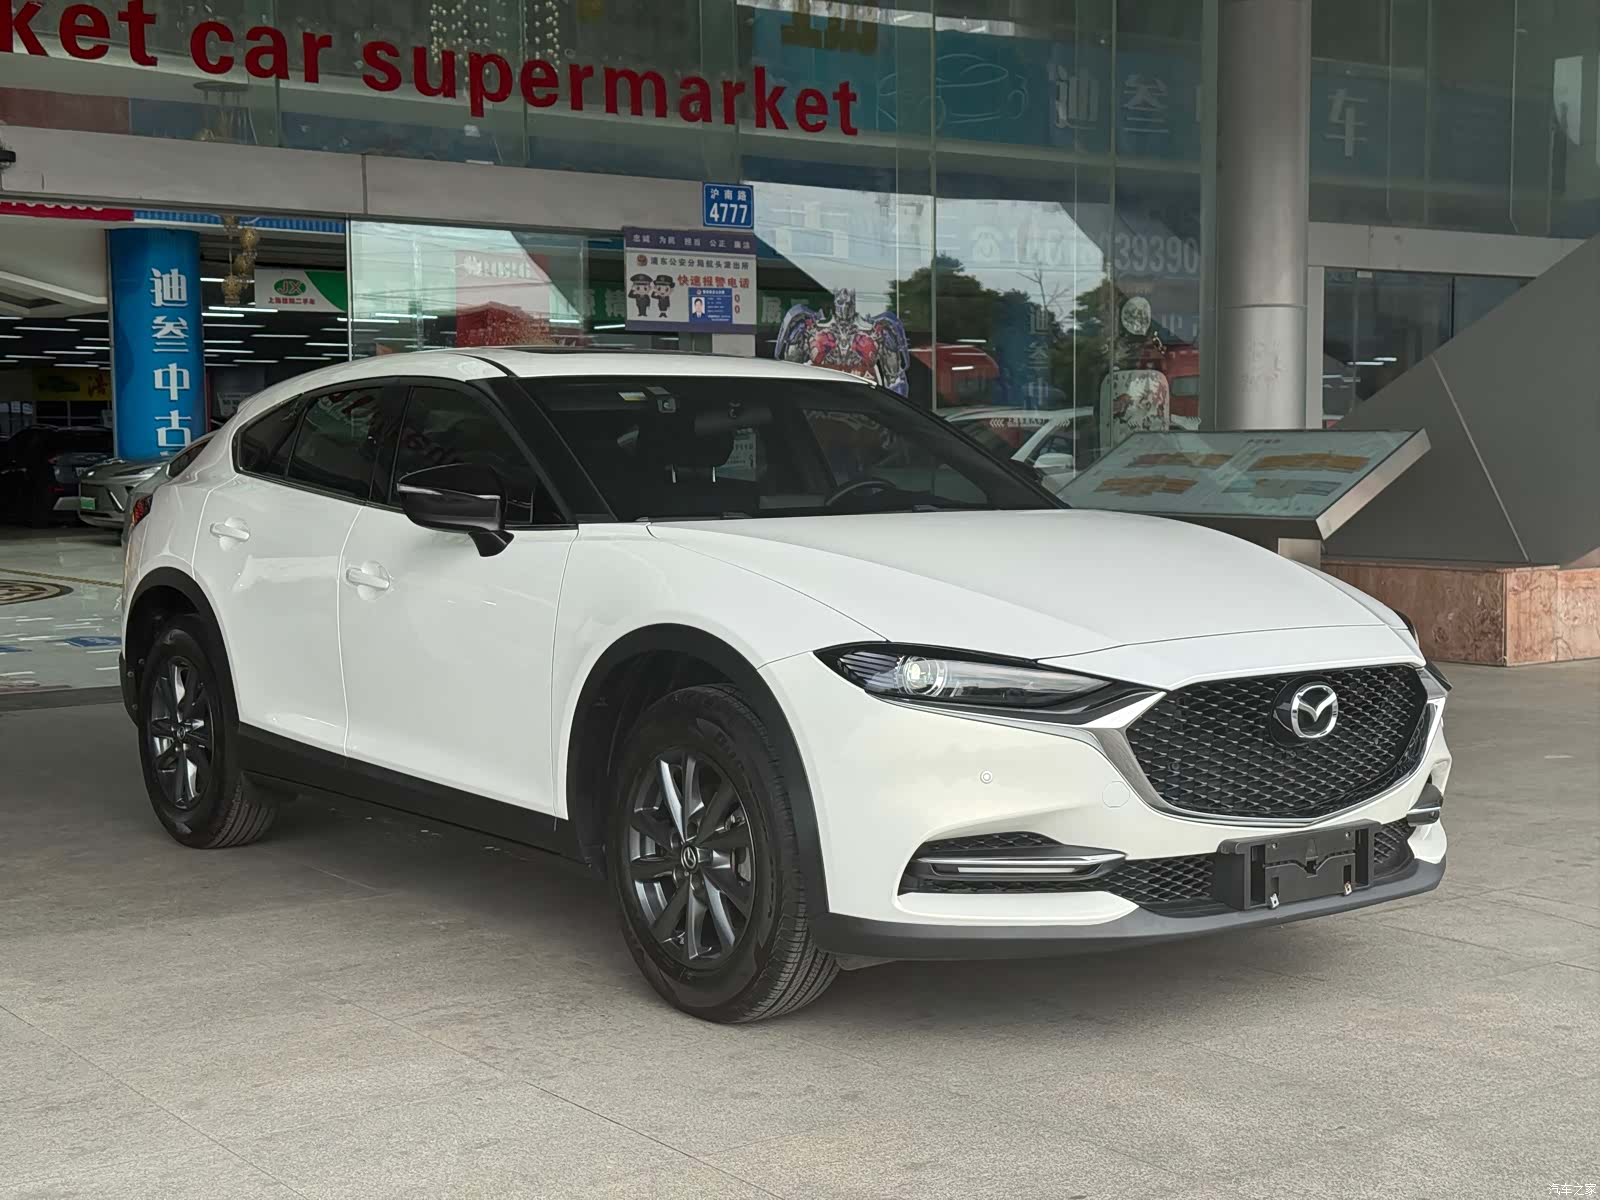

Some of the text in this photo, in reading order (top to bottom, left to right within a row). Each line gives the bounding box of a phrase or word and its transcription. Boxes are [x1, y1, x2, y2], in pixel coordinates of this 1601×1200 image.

[0, 0, 858, 136] ket car supermarket
[710, 188, 747, 201] 沪南路
[709, 202, 748, 224] 4777
[709, 239, 726, 249] 公正
[278, 280, 303, 295] JX
[677, 274, 750, 290] 快速报警电话
[149, 267, 191, 456] 迪叁中古
